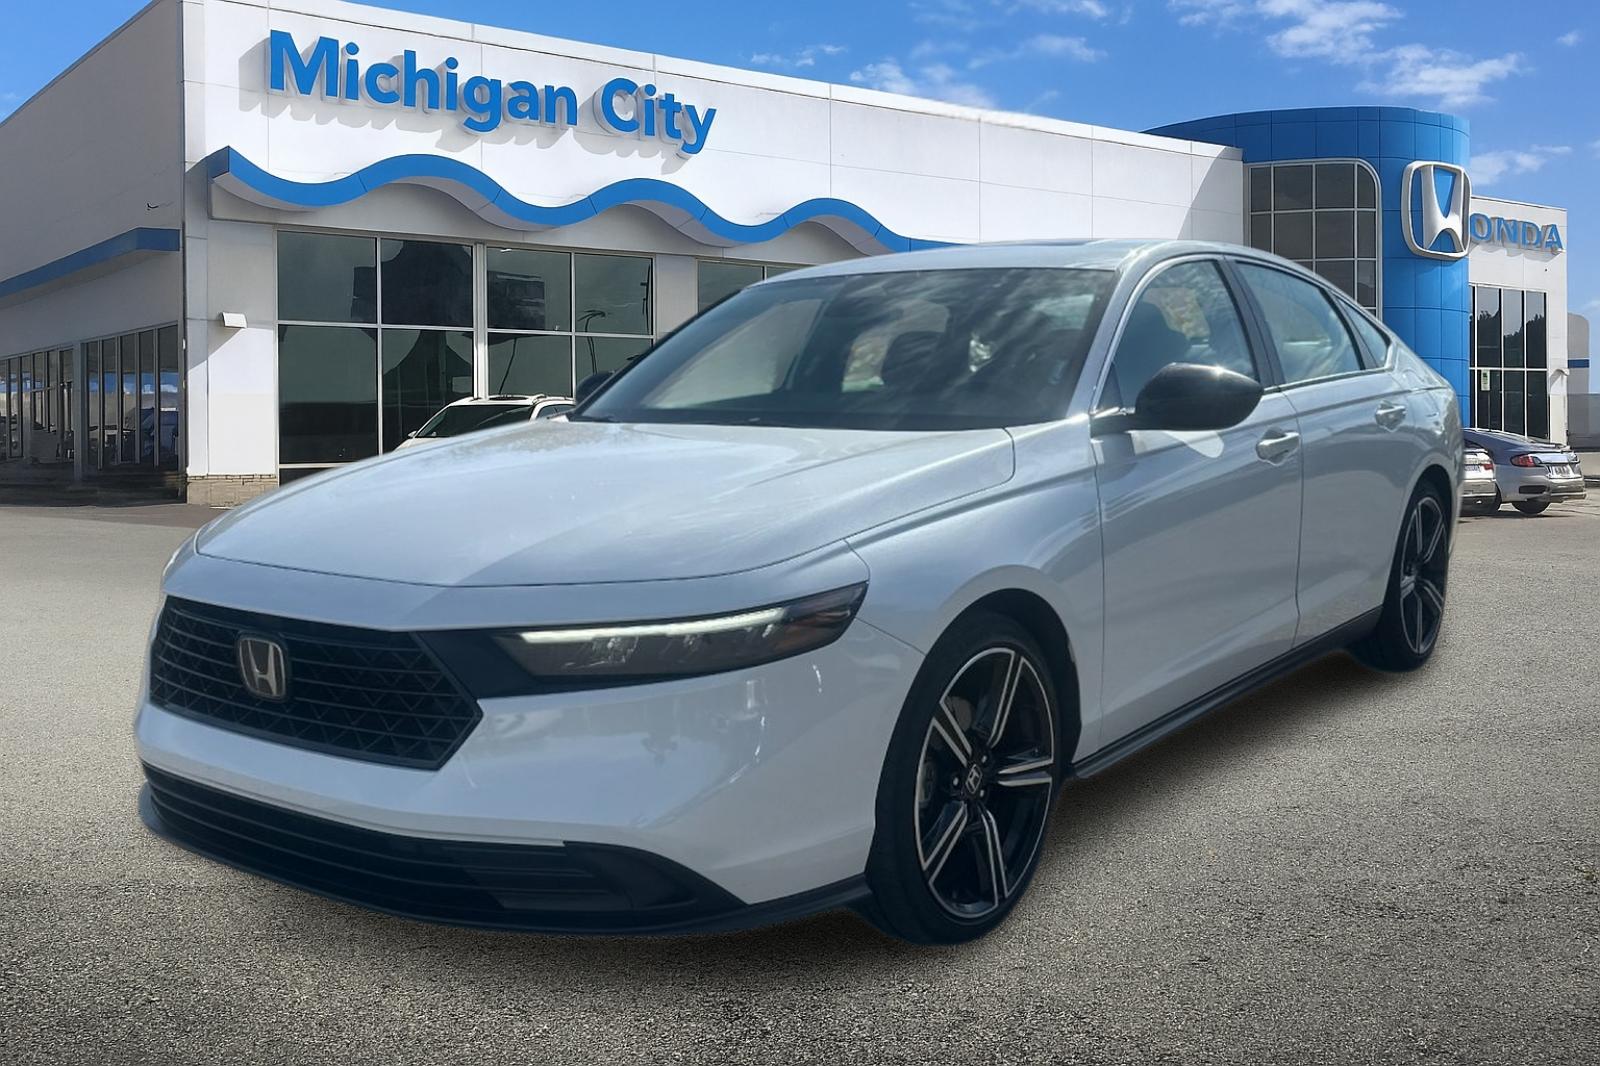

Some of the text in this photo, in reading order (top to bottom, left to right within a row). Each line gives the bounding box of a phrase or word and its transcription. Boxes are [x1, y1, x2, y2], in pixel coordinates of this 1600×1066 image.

[269, 28, 718, 155] Michigan City
[1469, 212, 1565, 250] ONDA
